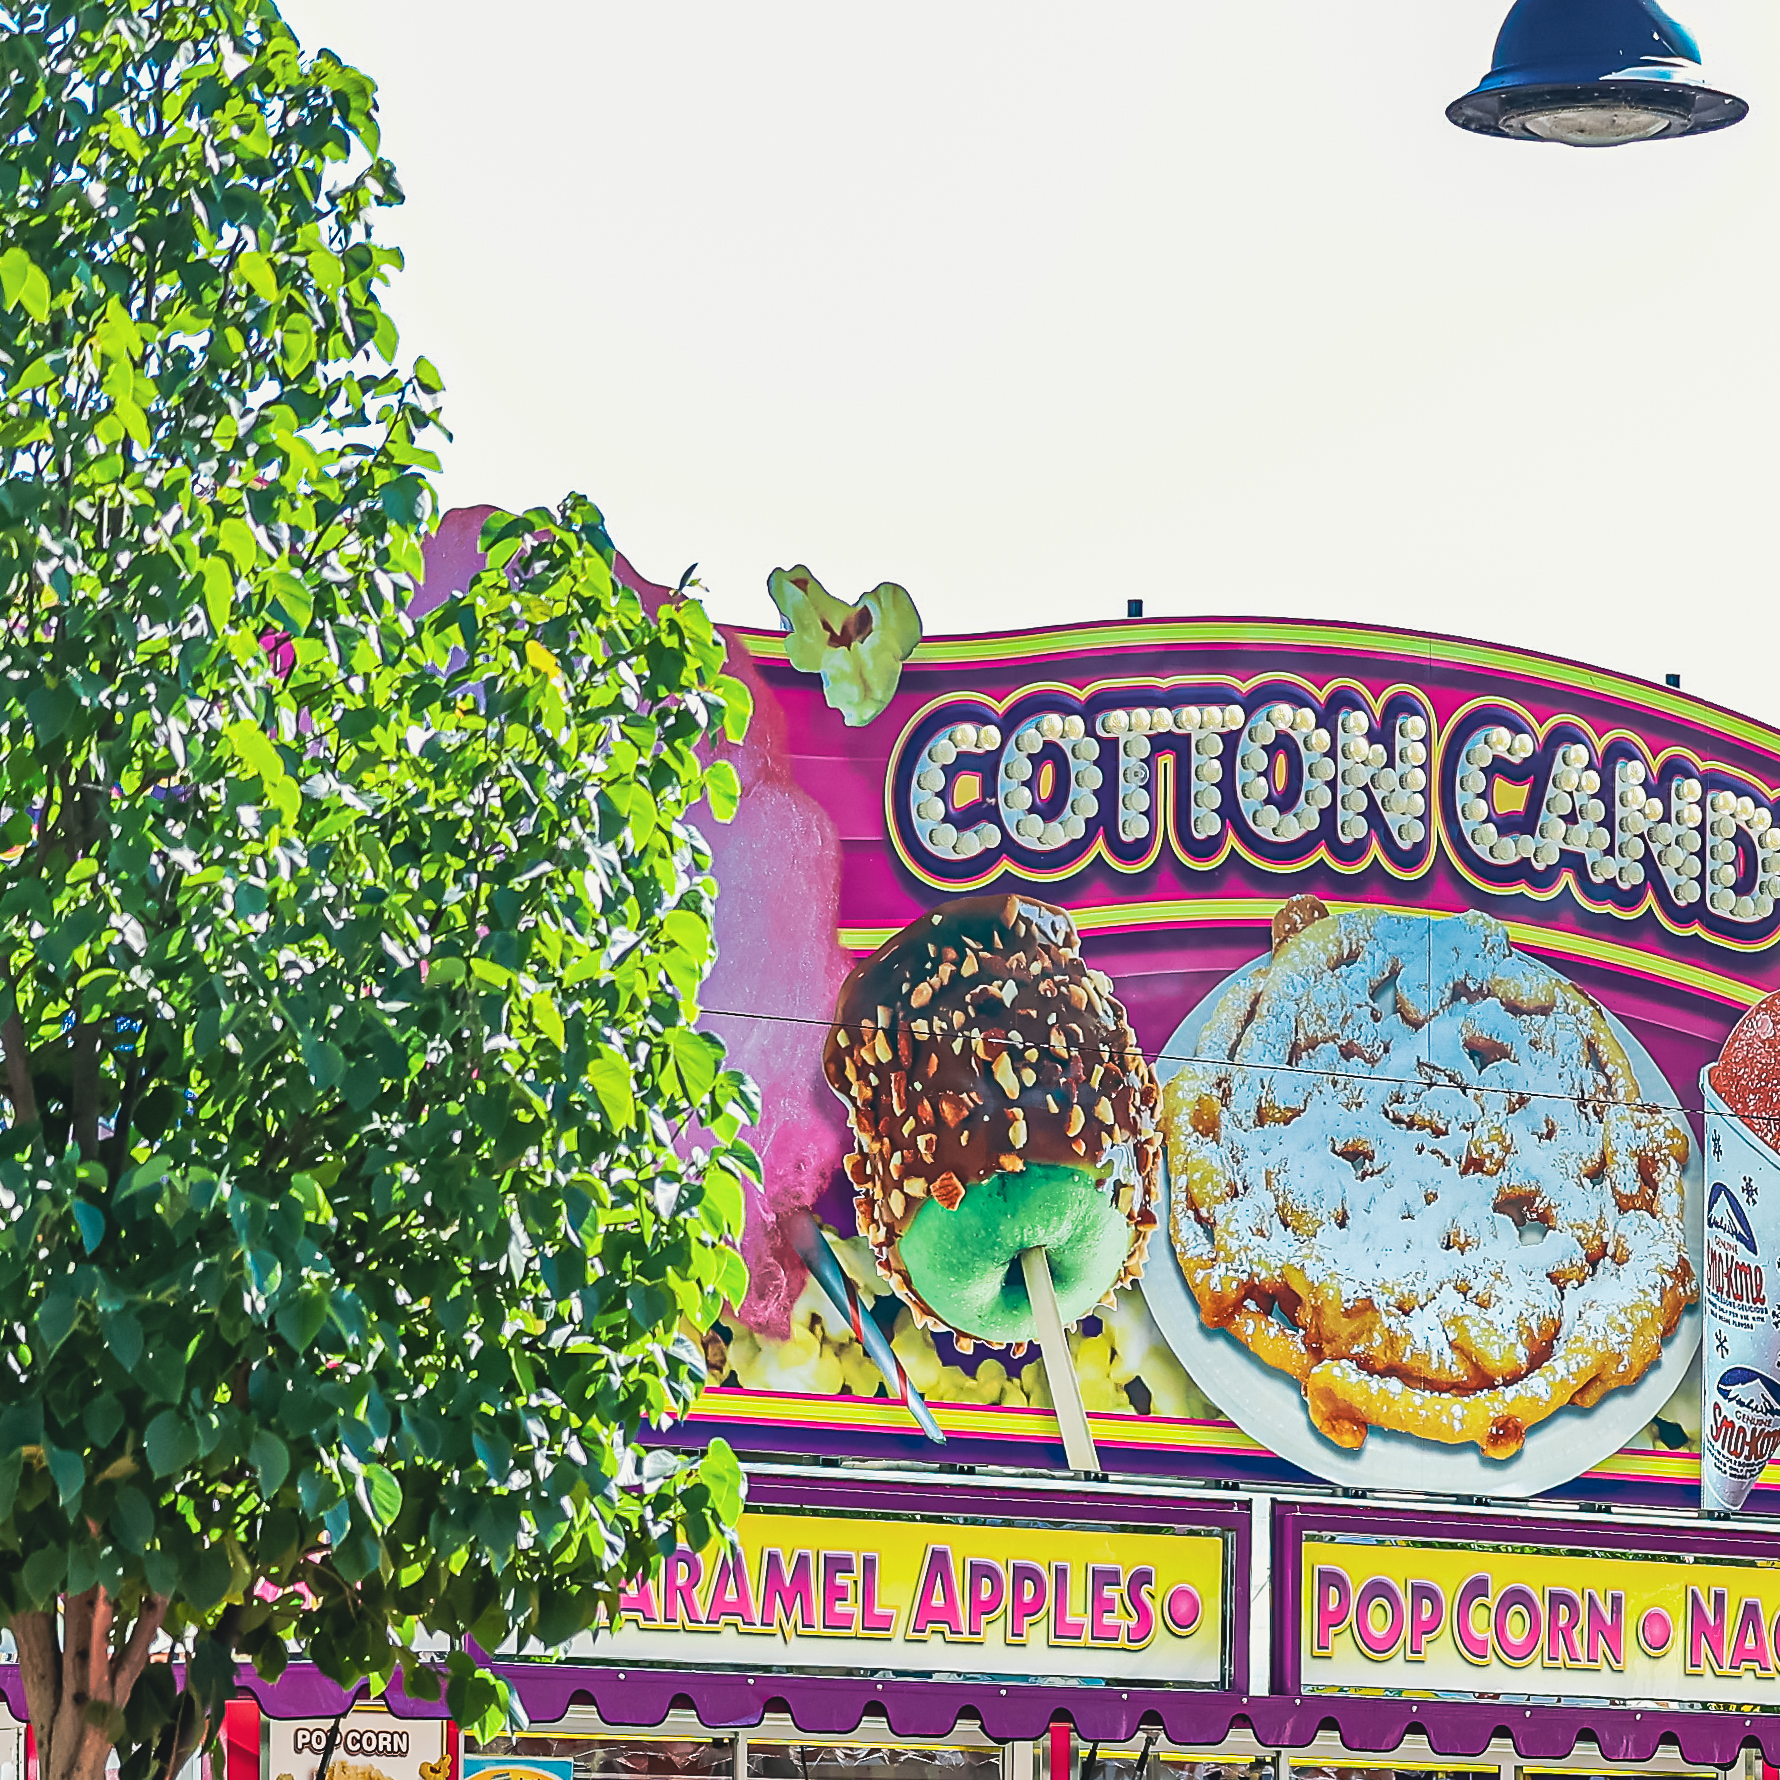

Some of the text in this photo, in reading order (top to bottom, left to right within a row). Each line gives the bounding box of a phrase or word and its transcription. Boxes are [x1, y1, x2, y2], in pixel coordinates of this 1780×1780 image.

[909, 700, 1427, 862] COTTON
[600, 1544, 1156, 1649] ARAMEL APPLES
[345, 1731, 410, 1754] CORN
